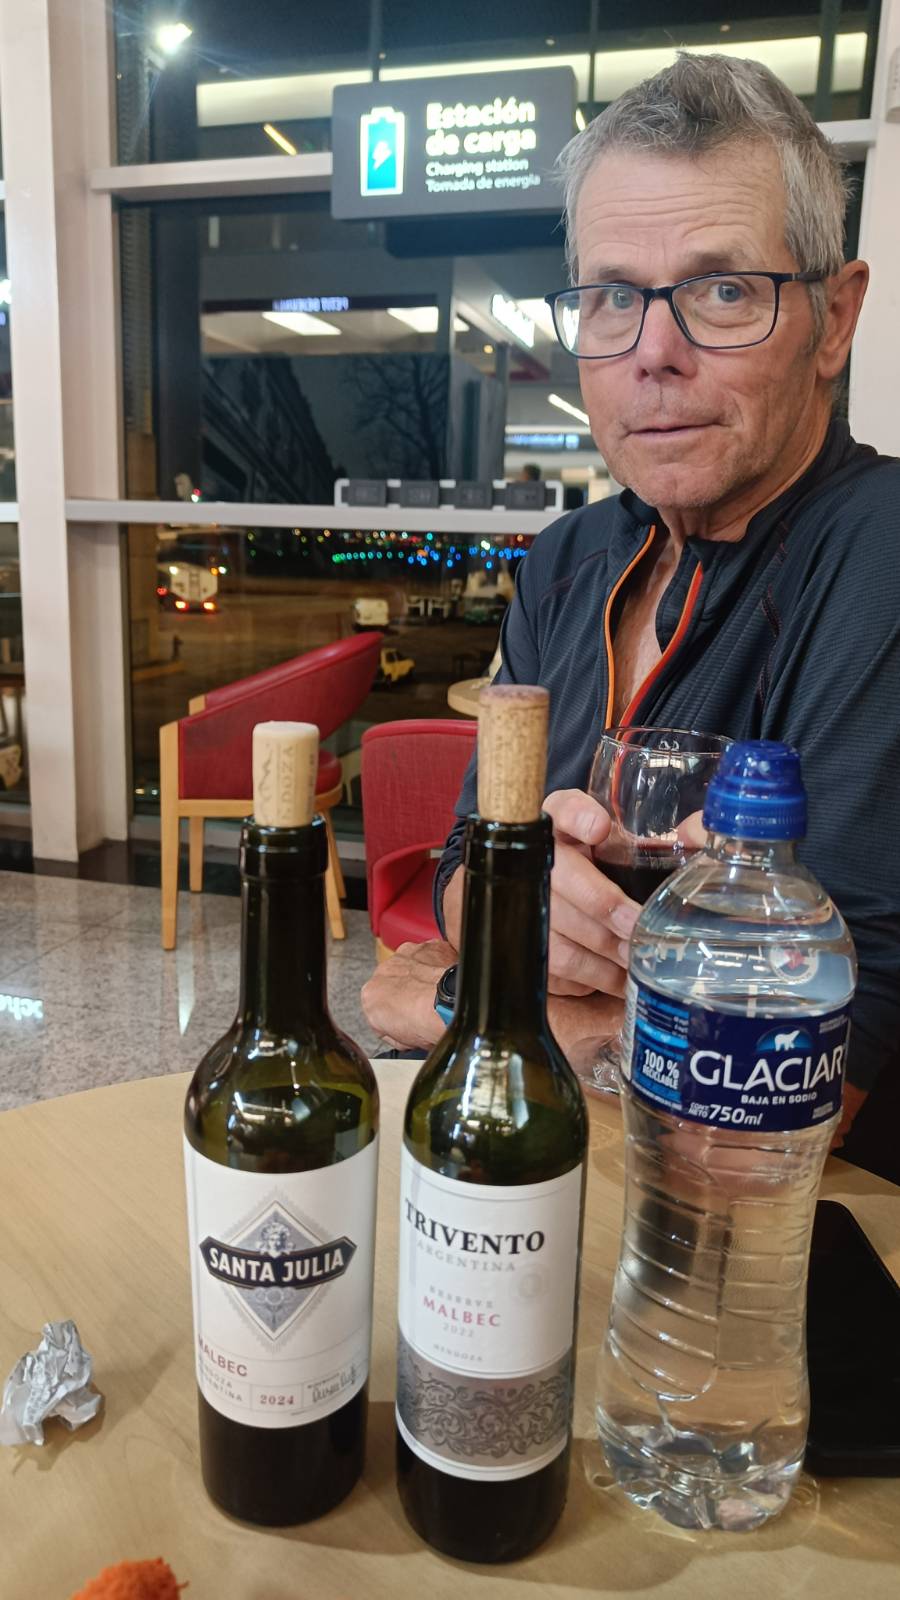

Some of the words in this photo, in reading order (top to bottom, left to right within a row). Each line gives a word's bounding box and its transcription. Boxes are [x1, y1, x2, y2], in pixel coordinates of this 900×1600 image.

[426, 96, 536, 130] Estación
[426, 129, 460, 156] de
[464, 128, 537, 157] carga
[426, 160, 484, 177] Charging
[485, 158, 529, 173] station
[426, 178, 476, 193] Tomada
[476, 176, 493, 190] de
[494, 174, 540, 189] energia
[644, 1048, 665, 1073] 100
[666, 1059, 680, 1081] %
[689, 1045, 843, 1093] GLACIAR
[708, 1103, 764, 1126] 750ml
[740, 1094, 770, 1106] BAJA
[772, 1095, 786, 1106] EN
[788, 1091, 817, 1105] SODIO
[404, 1198, 545, 1255] TRIVENTO
[208, 1247, 276, 1283] SANTA
[282, 1248, 345, 1283] JULIA
[416, 1239, 517, 1272] ARGENTINA
[423, 1295, 501, 1328] MALBEC
[259, 1393, 295, 1406] 2024
